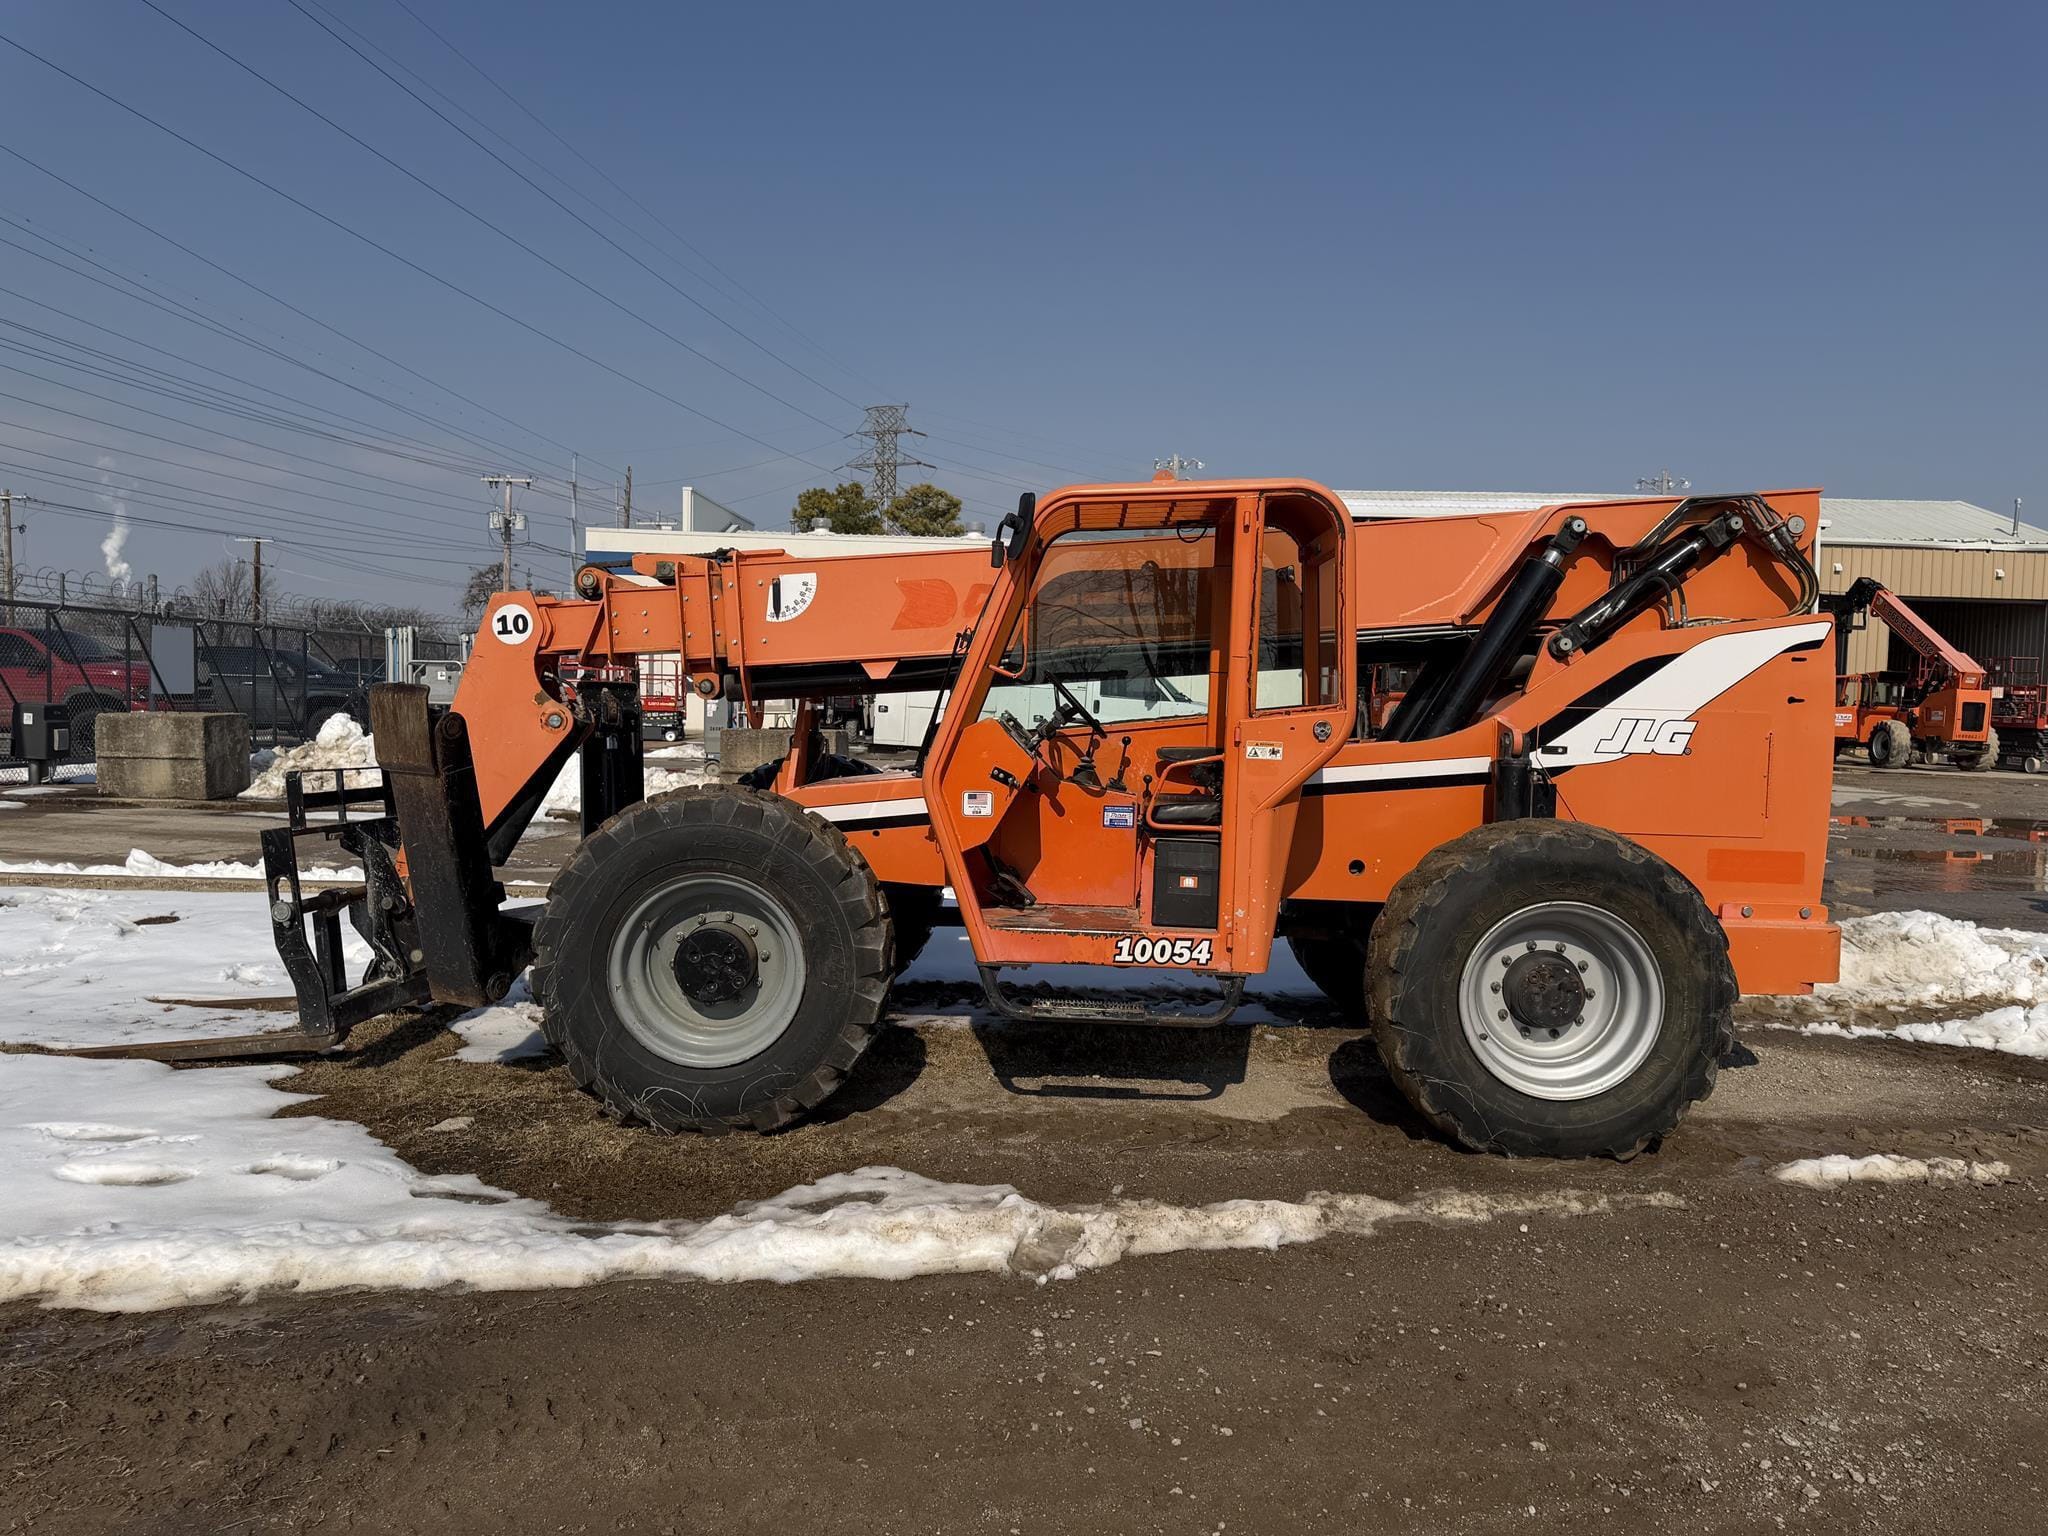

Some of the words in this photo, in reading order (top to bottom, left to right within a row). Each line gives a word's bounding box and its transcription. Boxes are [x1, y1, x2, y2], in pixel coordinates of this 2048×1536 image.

[497, 614, 529, 635] 10
[1594, 718, 1698, 756] JLG
[1113, 937, 1213, 965] 10054
